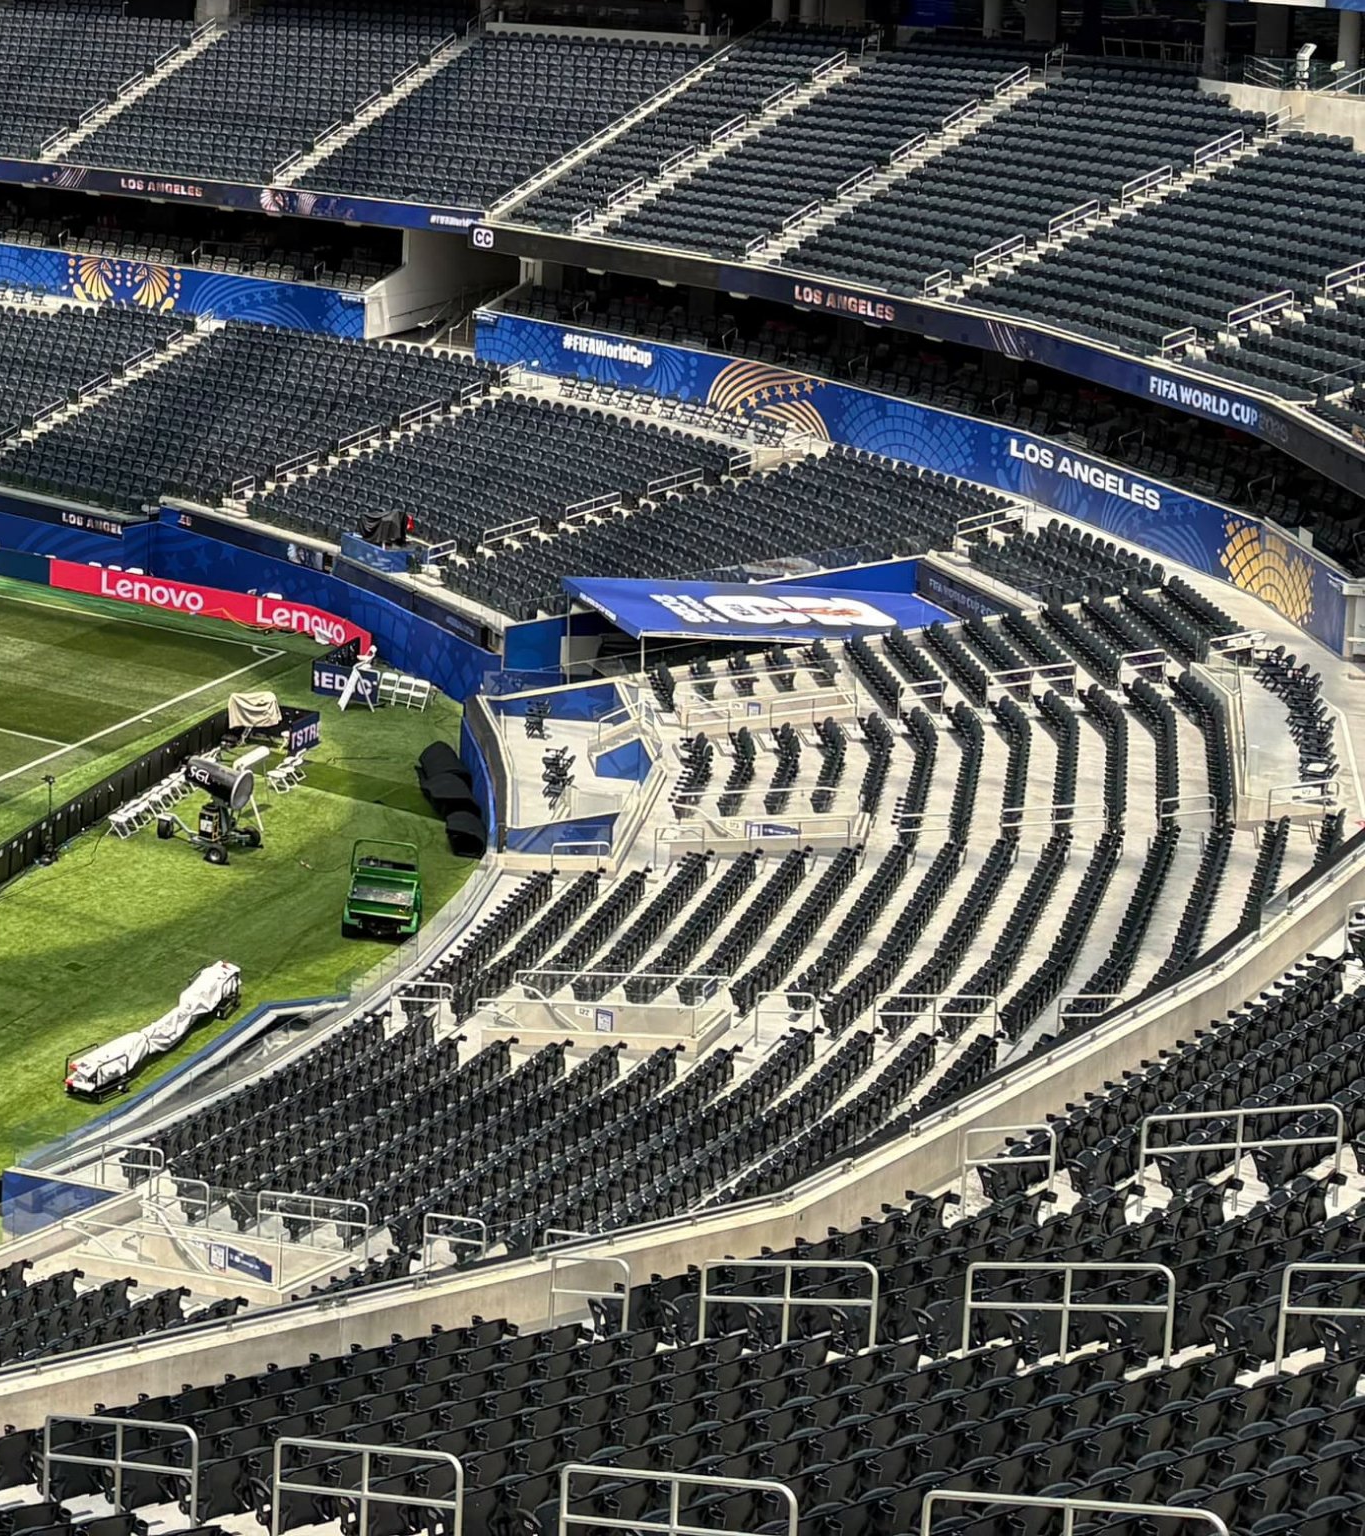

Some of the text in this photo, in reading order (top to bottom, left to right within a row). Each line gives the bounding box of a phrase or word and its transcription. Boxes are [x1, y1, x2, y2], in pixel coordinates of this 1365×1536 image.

[121, 178, 203, 197] LOS ANGELES
[476, 231, 492, 245] CC
[794, 285, 895, 321] LOS ANGELES
[563, 333, 652, 368] #FIFAWorldCup
[1150, 376, 1178, 401] FIFA
[1180, 384, 1229, 417] WORLD
[1231, 402, 1258, 425] CUP
[1010, 438, 1160, 511] LOS ANGELES
[101, 570, 204, 610] Lenovo
[256, 598, 346, 646] Lenovo
[188, 766, 211, 785] SGL
